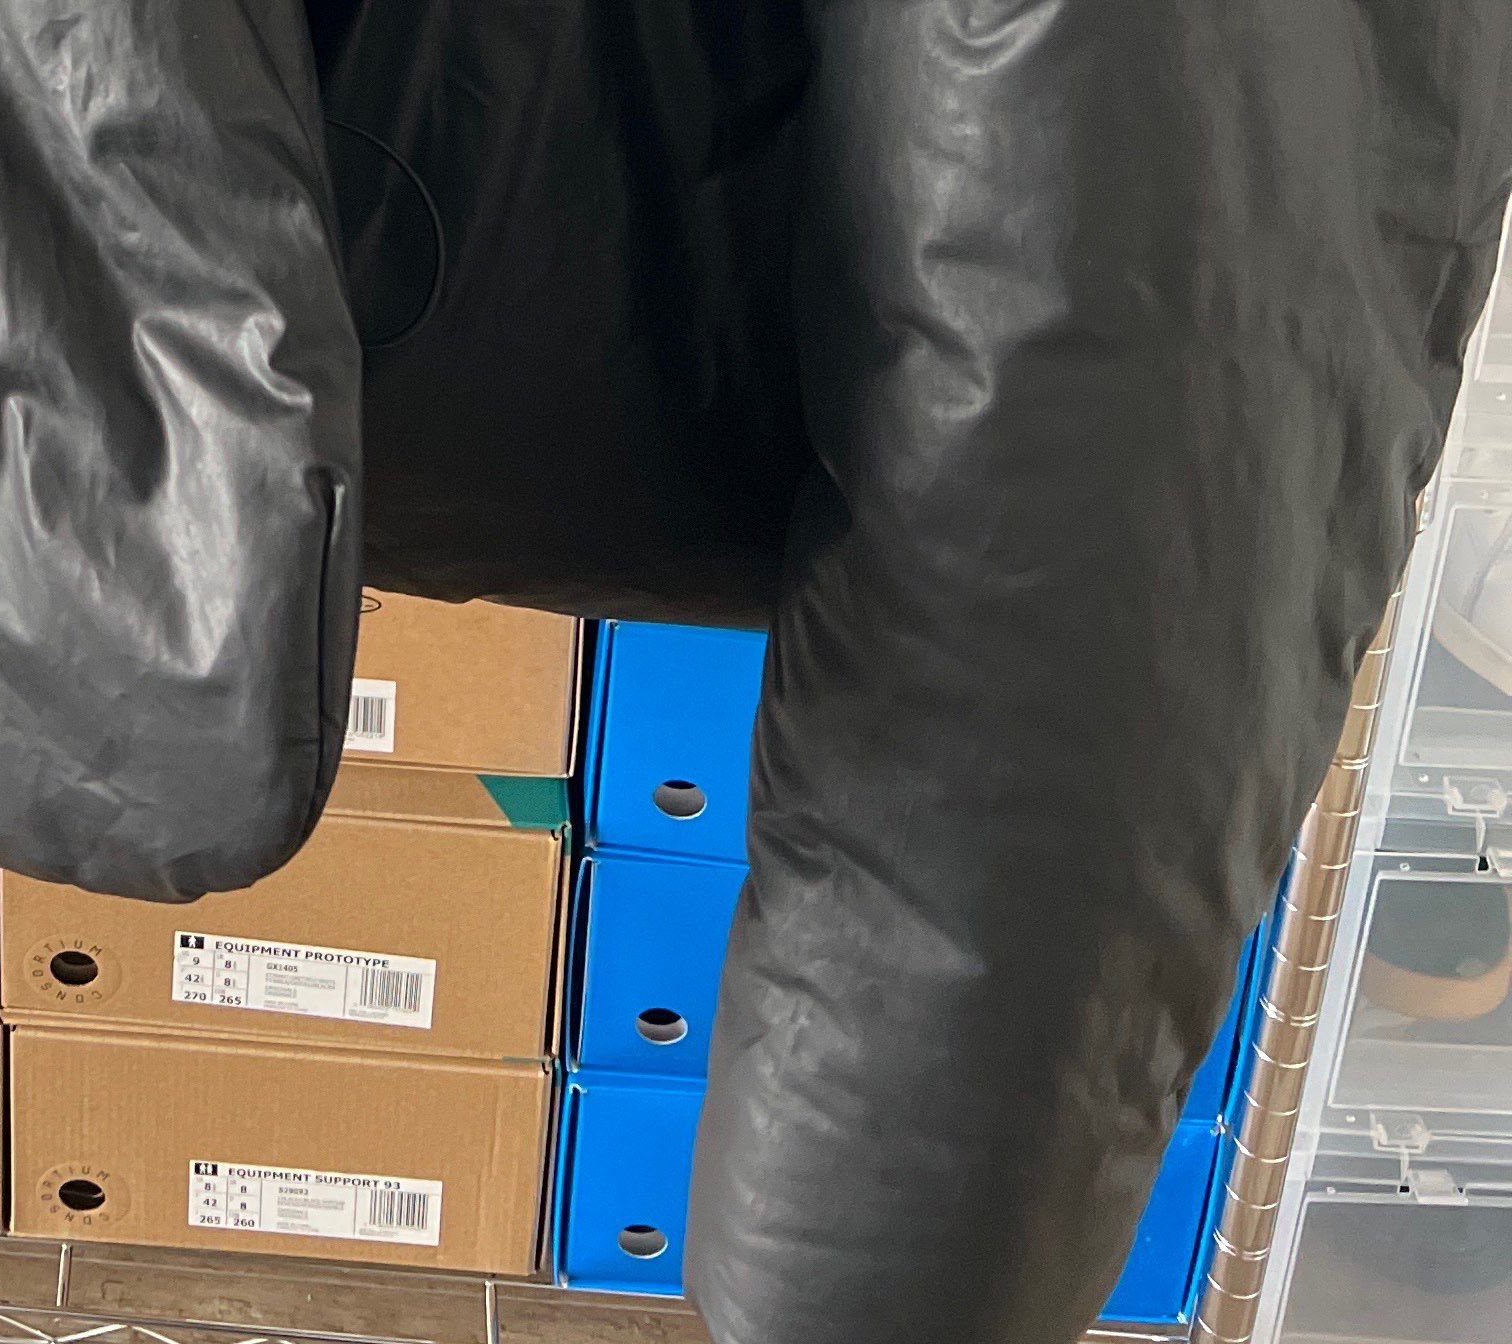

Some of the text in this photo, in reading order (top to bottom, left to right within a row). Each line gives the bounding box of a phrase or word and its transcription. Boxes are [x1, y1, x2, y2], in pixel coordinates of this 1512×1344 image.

[215, 941, 390, 968] EQUIPMENT PROTOTYPE
[184, 991, 207, 1001] 270
[219, 995, 242, 1005] 265
[228, 1168, 401, 1190] EQUIPMENT SUPPORT 93
[204, 1199, 217, 1207] 42
[199, 1215, 221, 1224] 265
[234, 1218, 255, 1227] 260
